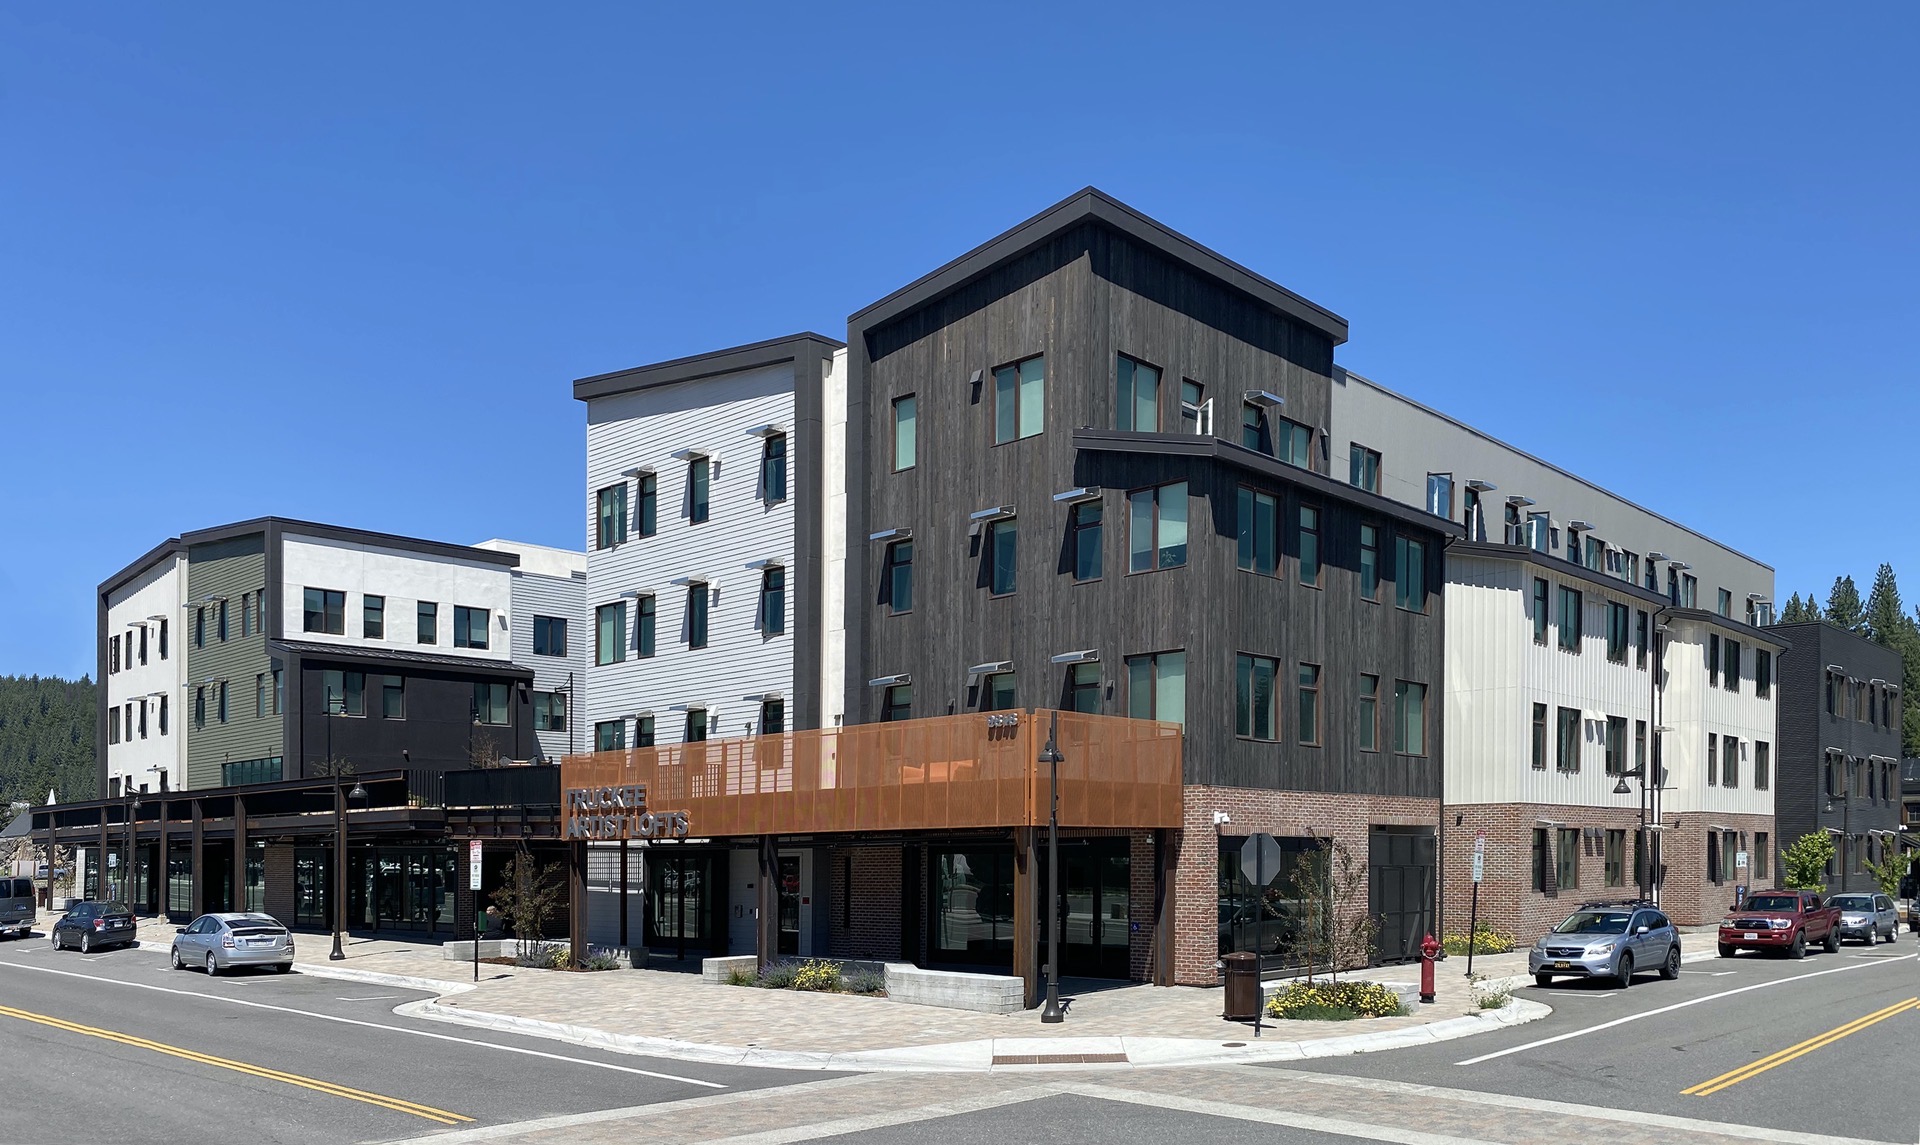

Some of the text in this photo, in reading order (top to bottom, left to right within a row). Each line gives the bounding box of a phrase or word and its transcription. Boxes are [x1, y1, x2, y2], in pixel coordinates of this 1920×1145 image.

[565, 784, 647, 810] TRUCKEE
[565, 811, 689, 838] ARTIST LOFTS
